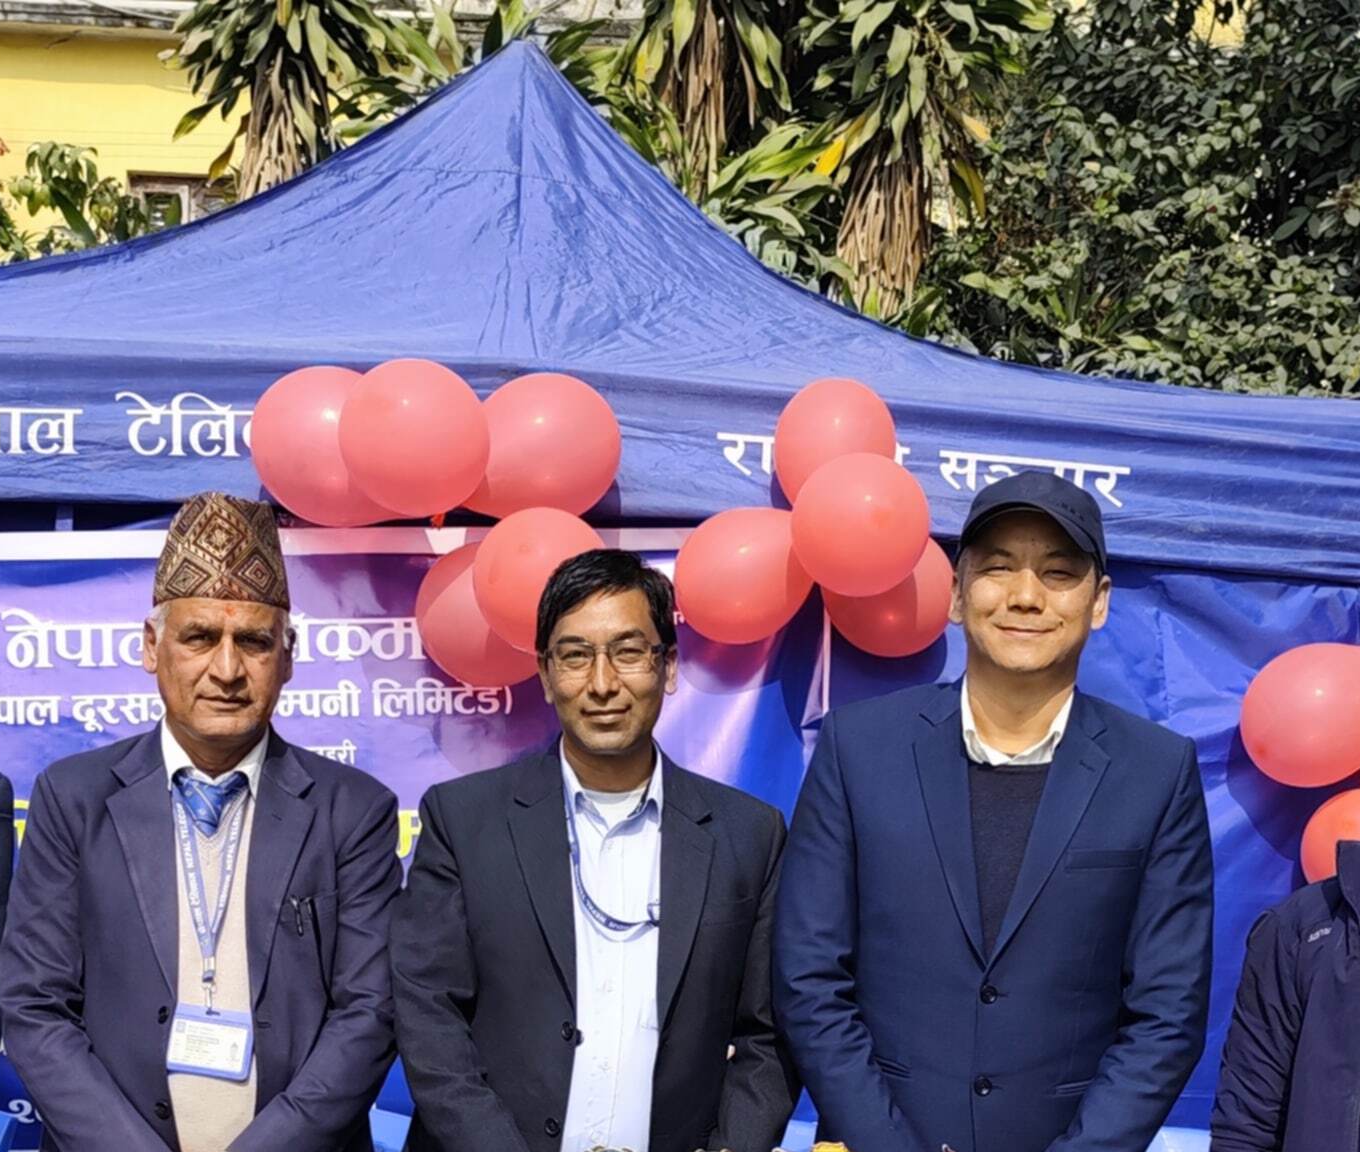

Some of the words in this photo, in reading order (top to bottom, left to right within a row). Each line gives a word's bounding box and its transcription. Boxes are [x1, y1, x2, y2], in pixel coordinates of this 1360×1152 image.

[114, 392, 255, 457] टेलि
[275, 681, 362, 718] म्पनी
[371, 676, 513, 718] लिमिटेड)
